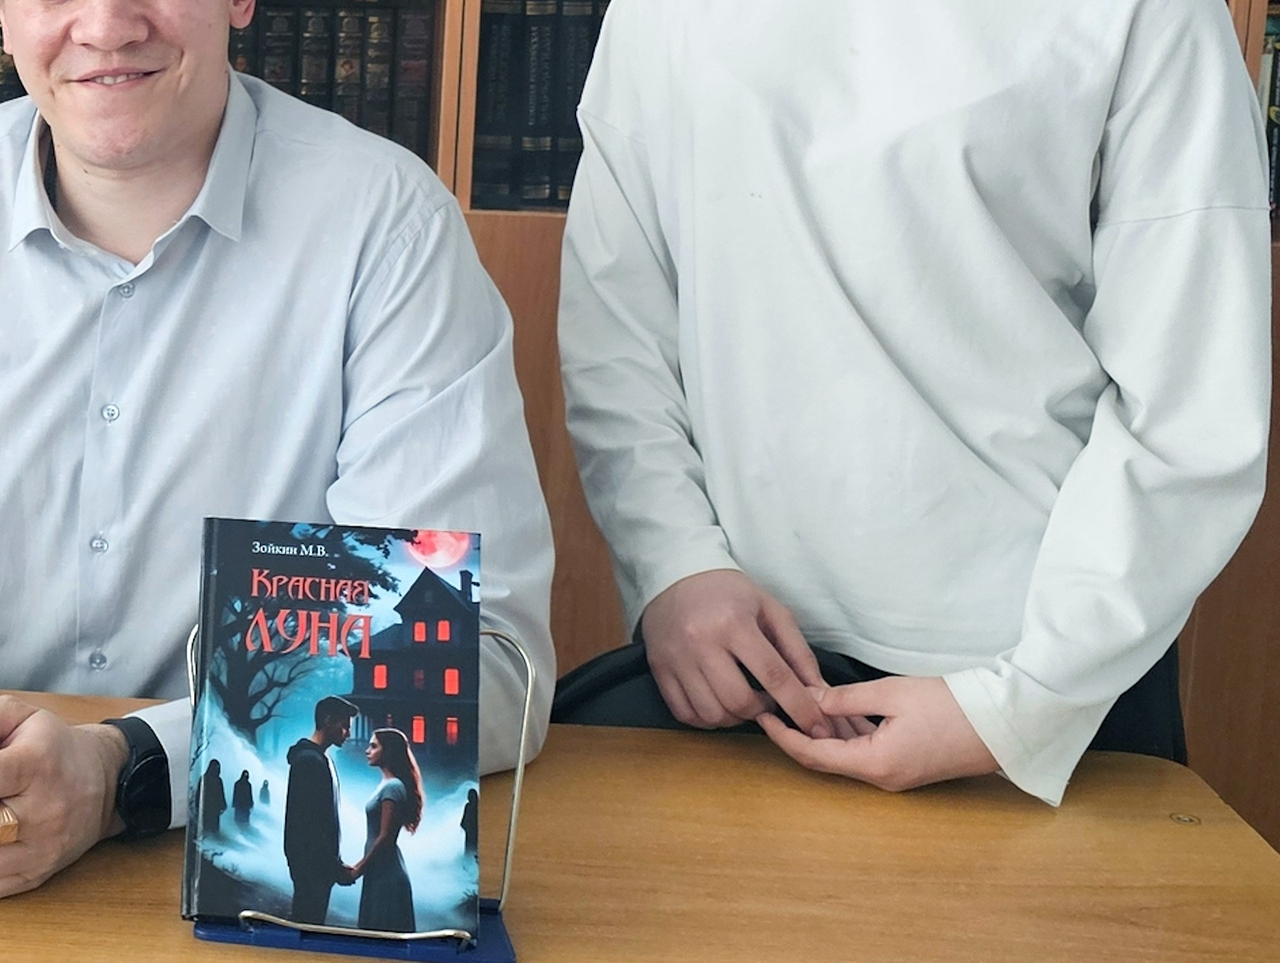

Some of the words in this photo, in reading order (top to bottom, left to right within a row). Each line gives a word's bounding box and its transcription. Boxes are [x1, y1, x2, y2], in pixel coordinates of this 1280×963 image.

[251, 540, 298, 556] Зойкин
[299, 543, 330, 559] М.В.
[250, 568, 371, 605] КРАСНАЯ
[244, 607, 373, 659] ЛУНА
